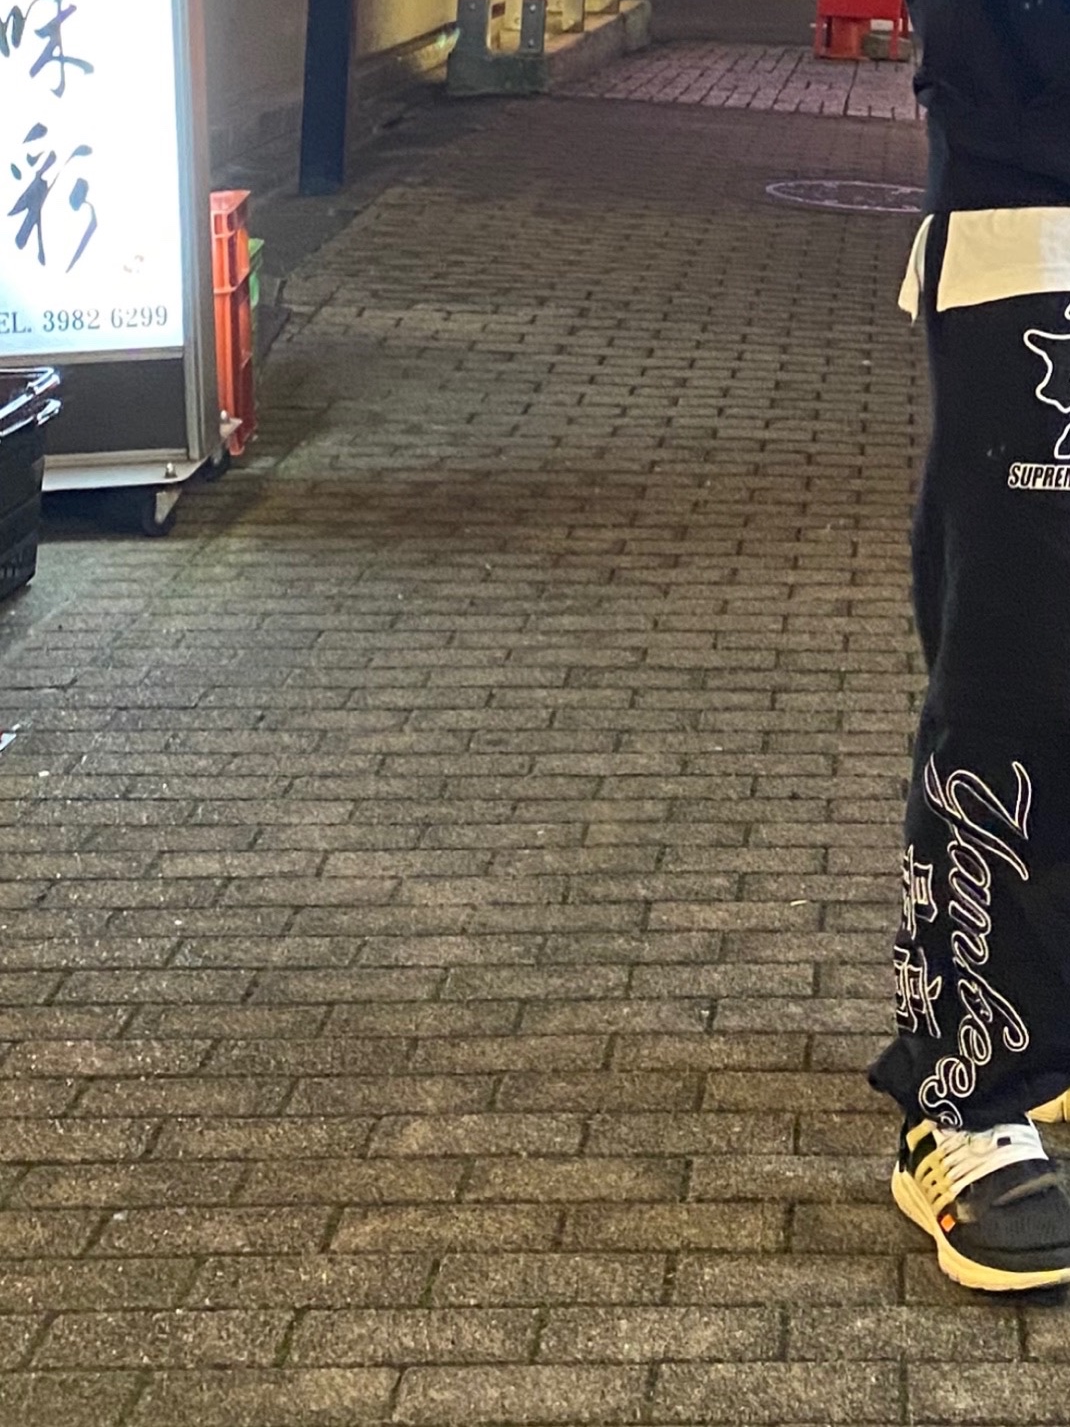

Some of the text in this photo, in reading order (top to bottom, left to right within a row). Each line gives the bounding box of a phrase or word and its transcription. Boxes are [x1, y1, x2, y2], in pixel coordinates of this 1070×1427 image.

[43, 309, 100, 332] 3982
[111, 304, 168, 329] 6299
[918, 752, 1032, 1129] Yankees
